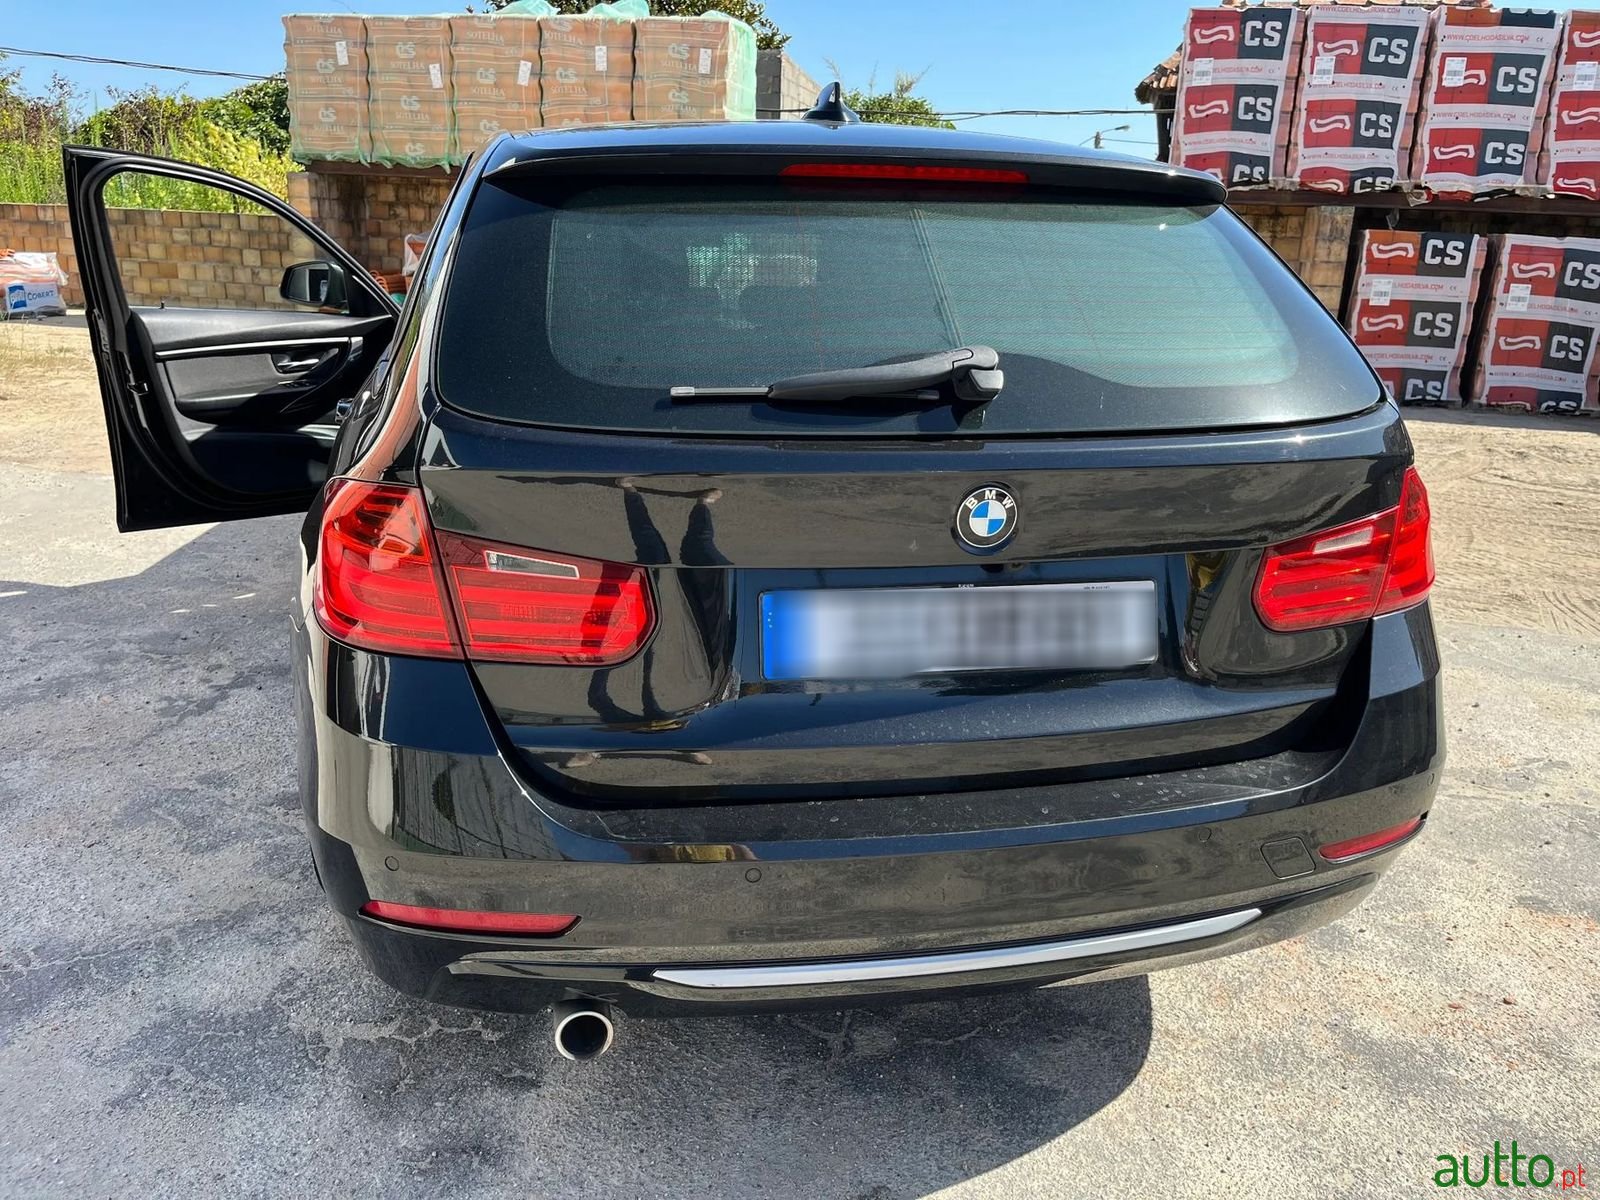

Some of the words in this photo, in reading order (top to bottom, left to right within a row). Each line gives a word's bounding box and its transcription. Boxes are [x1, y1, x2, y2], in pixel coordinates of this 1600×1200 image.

[1244, 20, 1282, 47] CS
[1368, 37, 1409, 65] CS
[1496, 66, 1538, 94] CS
[1238, 96, 1273, 122] CS
[1360, 112, 1393, 138] CS
[1484, 141, 1525, 165] CS
[1232, 163, 1265, 183] CS
[1353, 176, 1393, 194] CS
[1424, 239, 1465, 266] CS
[1563, 261, 1600, 290] CS
[1413, 312, 1454, 337] CS
[1549, 334, 1585, 362] CS
[1405, 378, 1443, 400] CS
[965, 489, 1014, 510] BMW
